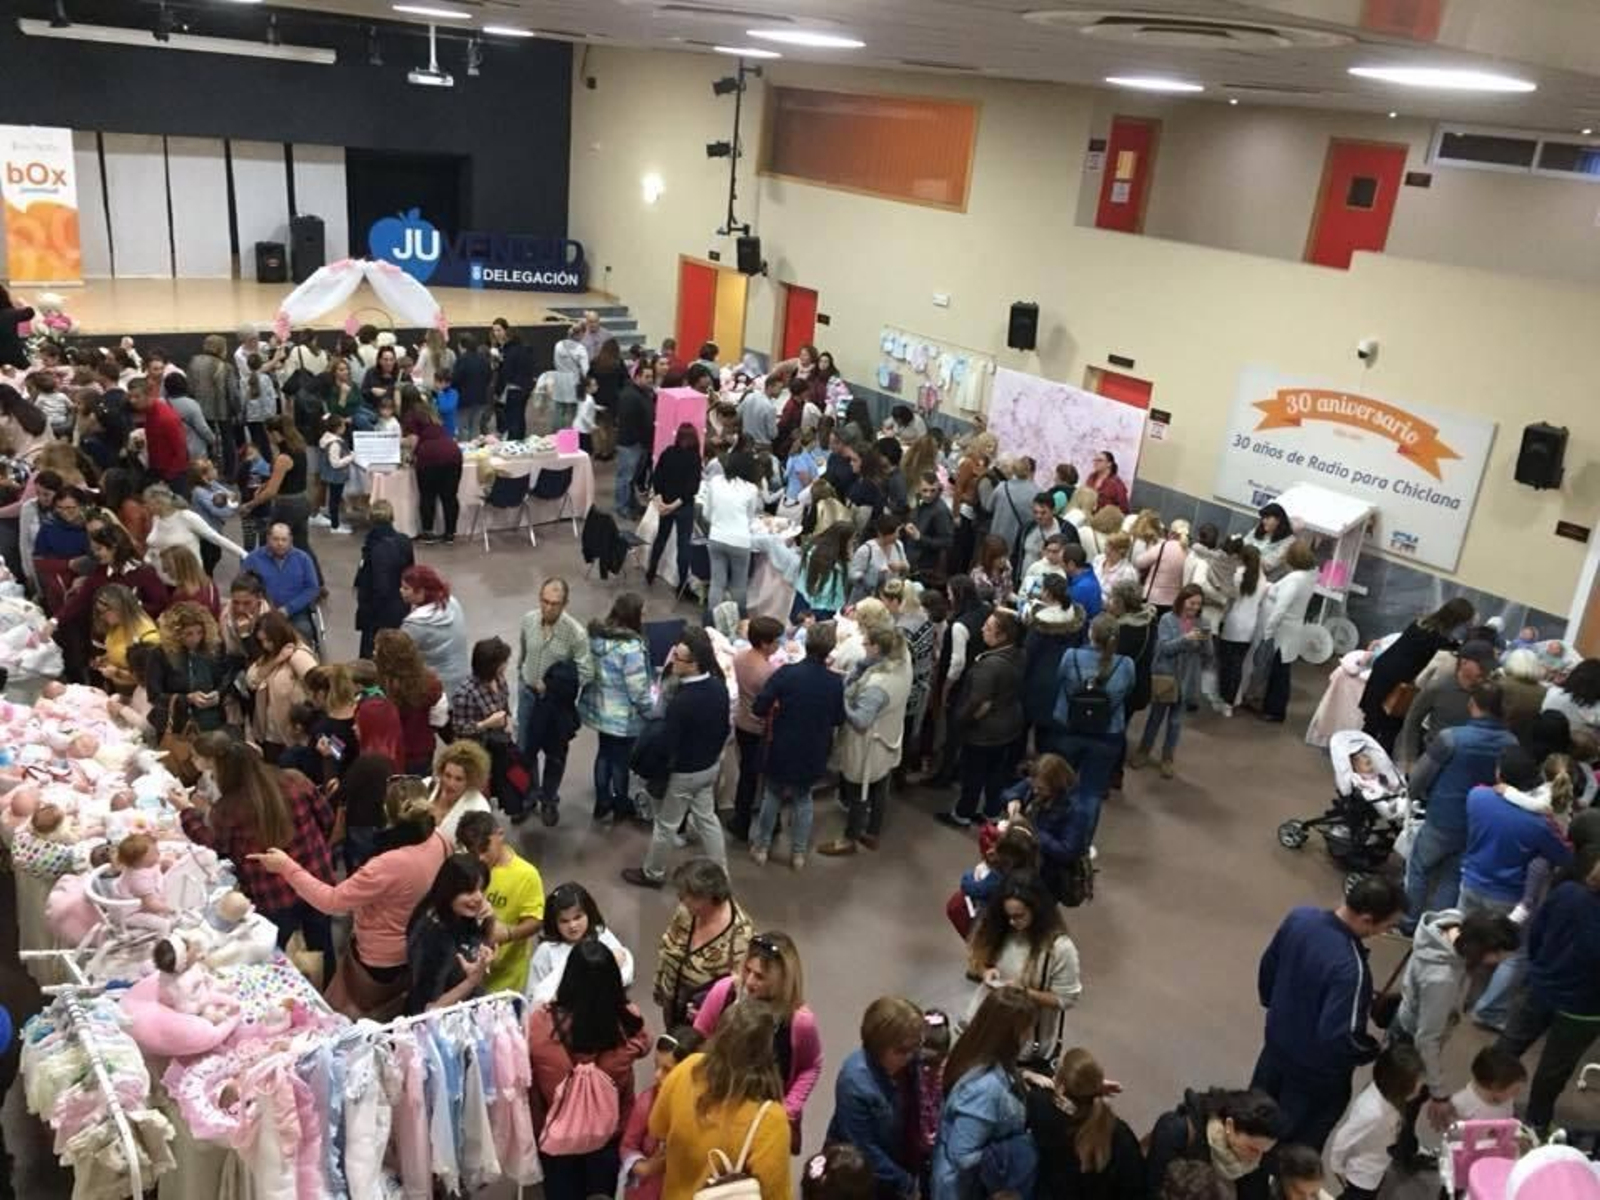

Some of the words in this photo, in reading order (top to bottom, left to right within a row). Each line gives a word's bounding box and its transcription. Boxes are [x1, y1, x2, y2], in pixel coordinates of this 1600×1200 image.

[7, 162, 67, 187] bOx
[482, 267, 579, 286] DELEGACIÓN
[1286, 392, 1311, 414] 30
[1316, 396, 1419, 445] aniversario
[1232, 434, 1251, 450] 30
[1252, 441, 1285, 460] años
[1286, 451, 1305, 466] de
[1307, 455, 1350, 479] Radio
[1350, 470, 1389, 491] para
[1392, 479, 1461, 511] Chiclana
